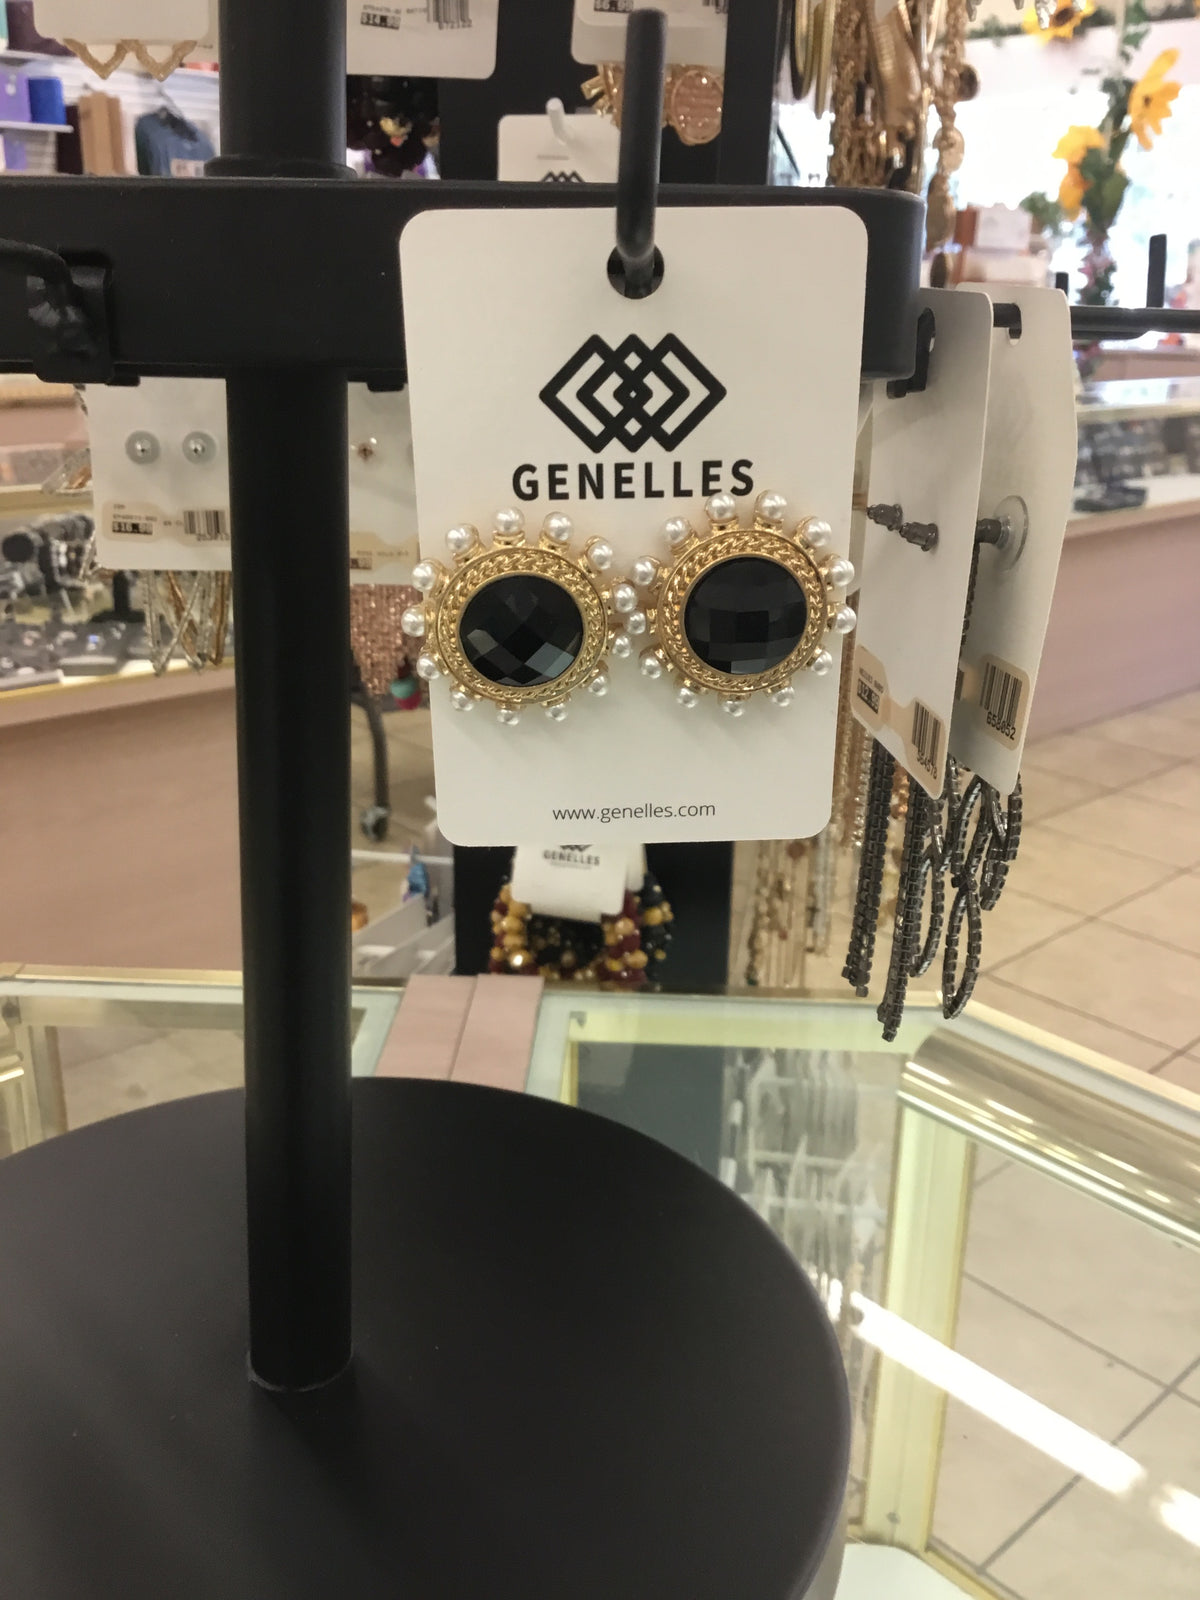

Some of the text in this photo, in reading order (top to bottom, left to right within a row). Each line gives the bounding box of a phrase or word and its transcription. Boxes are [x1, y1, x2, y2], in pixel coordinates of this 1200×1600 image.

[512, 459, 754, 501] GENELLES
[552, 803, 716, 824] www.genelles.com
[543, 849, 600, 866] GENELLES
